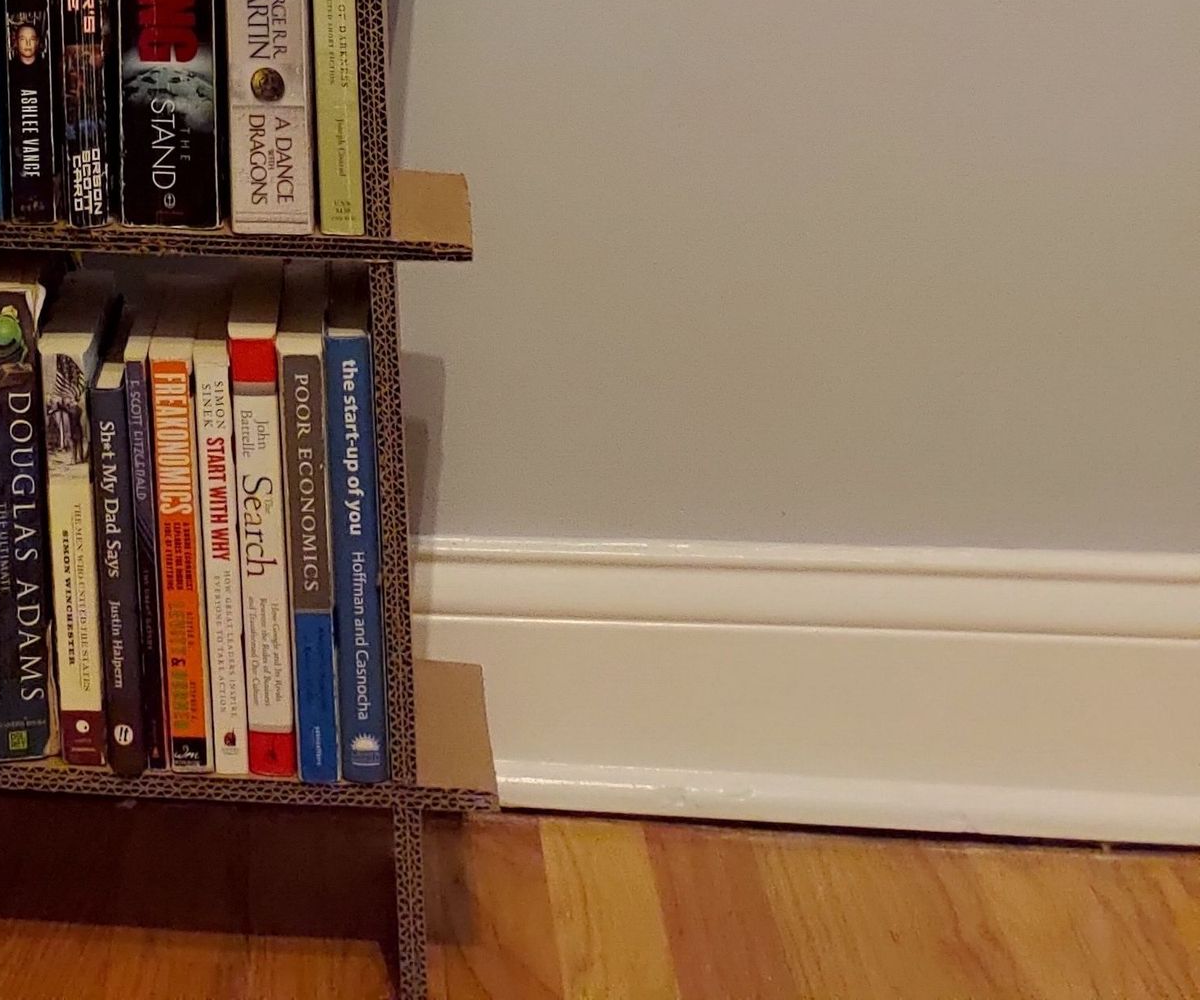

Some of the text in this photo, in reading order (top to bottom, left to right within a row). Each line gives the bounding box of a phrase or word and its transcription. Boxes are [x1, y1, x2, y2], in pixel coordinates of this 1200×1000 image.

[337, 3, 346, 20] OF
[338, 25, 349, 89] DARKNESS
[19, 89, 40, 178] ASHLEE VANCE
[150, 97, 176, 190] STAND
[180, 128, 191, 161] THE
[248, 113, 268, 205] DRAGONS
[267, 148, 275, 170] WITH
[274, 116, 294, 203] A DANCE
[71, 154, 84, 212] CARD
[81, 148, 93, 215] SCOTT
[91, 146, 103, 216] ORSON
[202, 383, 214, 428] SINEK
[214, 380, 226, 429] SIMON
[240, 409, 256, 458] Battelle
[255, 419, 270, 450] John
[129, 390, 147, 501] SCOTT FITZGERALD
[154, 372, 193, 515] FREAKONOMICS
[341, 359, 364, 535] the start-up of you
[7, 391, 38, 562] DOUGLAS
[102, 464, 118, 493] My
[206, 436, 231, 562] START WITH WHY
[264, 498, 273, 515] The
[293, 373, 319, 592] POOR ECONOMICS
[73, 503, 82, 522] THE
[76, 527, 85, 552] MEN
[104, 497, 121, 534] Dad
[242, 474, 278, 577] Search
[104, 539, 122, 578] Says
[61, 529, 75, 666] SIMON WINCHESTER
[270, 603, 279, 622] How
[16, 578, 45, 702] ADAMS
[108, 600, 125, 689] Justin Halpern
[214, 575, 228, 714] EVERYONE TO TAKE ACTION
[223, 570, 238, 719] HOW GREAT LEADERS INSPIRE
[270, 624, 281, 650] Google
[273, 652, 281, 666] and
[351, 551, 372, 721] Hoffman and Casnocha
[81, 649, 91, 692] STATES
[274, 680, 283, 702] Rivals
